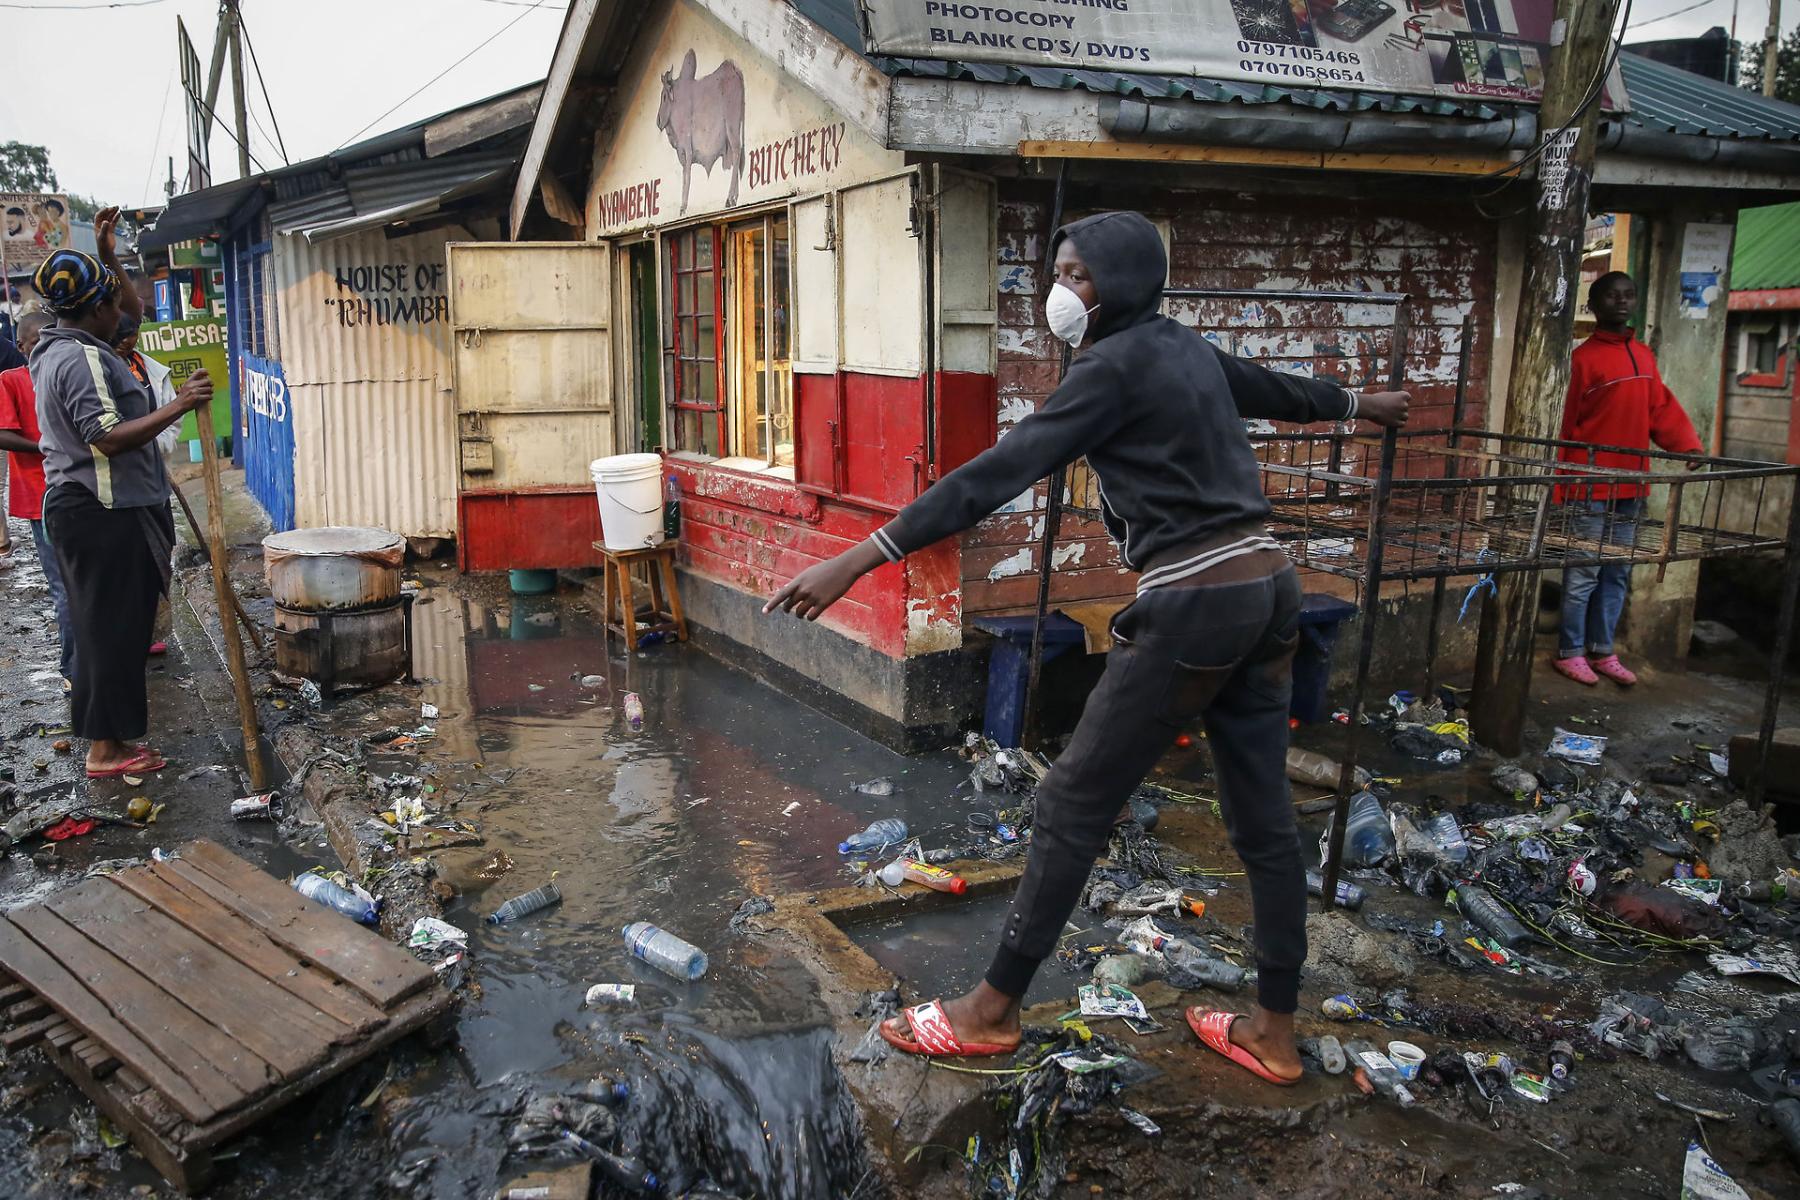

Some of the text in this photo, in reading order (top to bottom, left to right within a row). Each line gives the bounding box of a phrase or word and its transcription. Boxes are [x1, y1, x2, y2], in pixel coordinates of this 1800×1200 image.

[925, 1, 1076, 29] PHOTOCOPY
[930, 27, 1017, 49] BLANK
[1087, 42, 1151, 62] DVD'S
[1236, 40, 1361, 65] 0797105468
[1239, 59, 1365, 82] 0707058654
[748, 121, 845, 189] BUTCHERY
[598, 178, 661, 230] NYAMBENE
[335, 263, 446, 293] HOUSE OF
